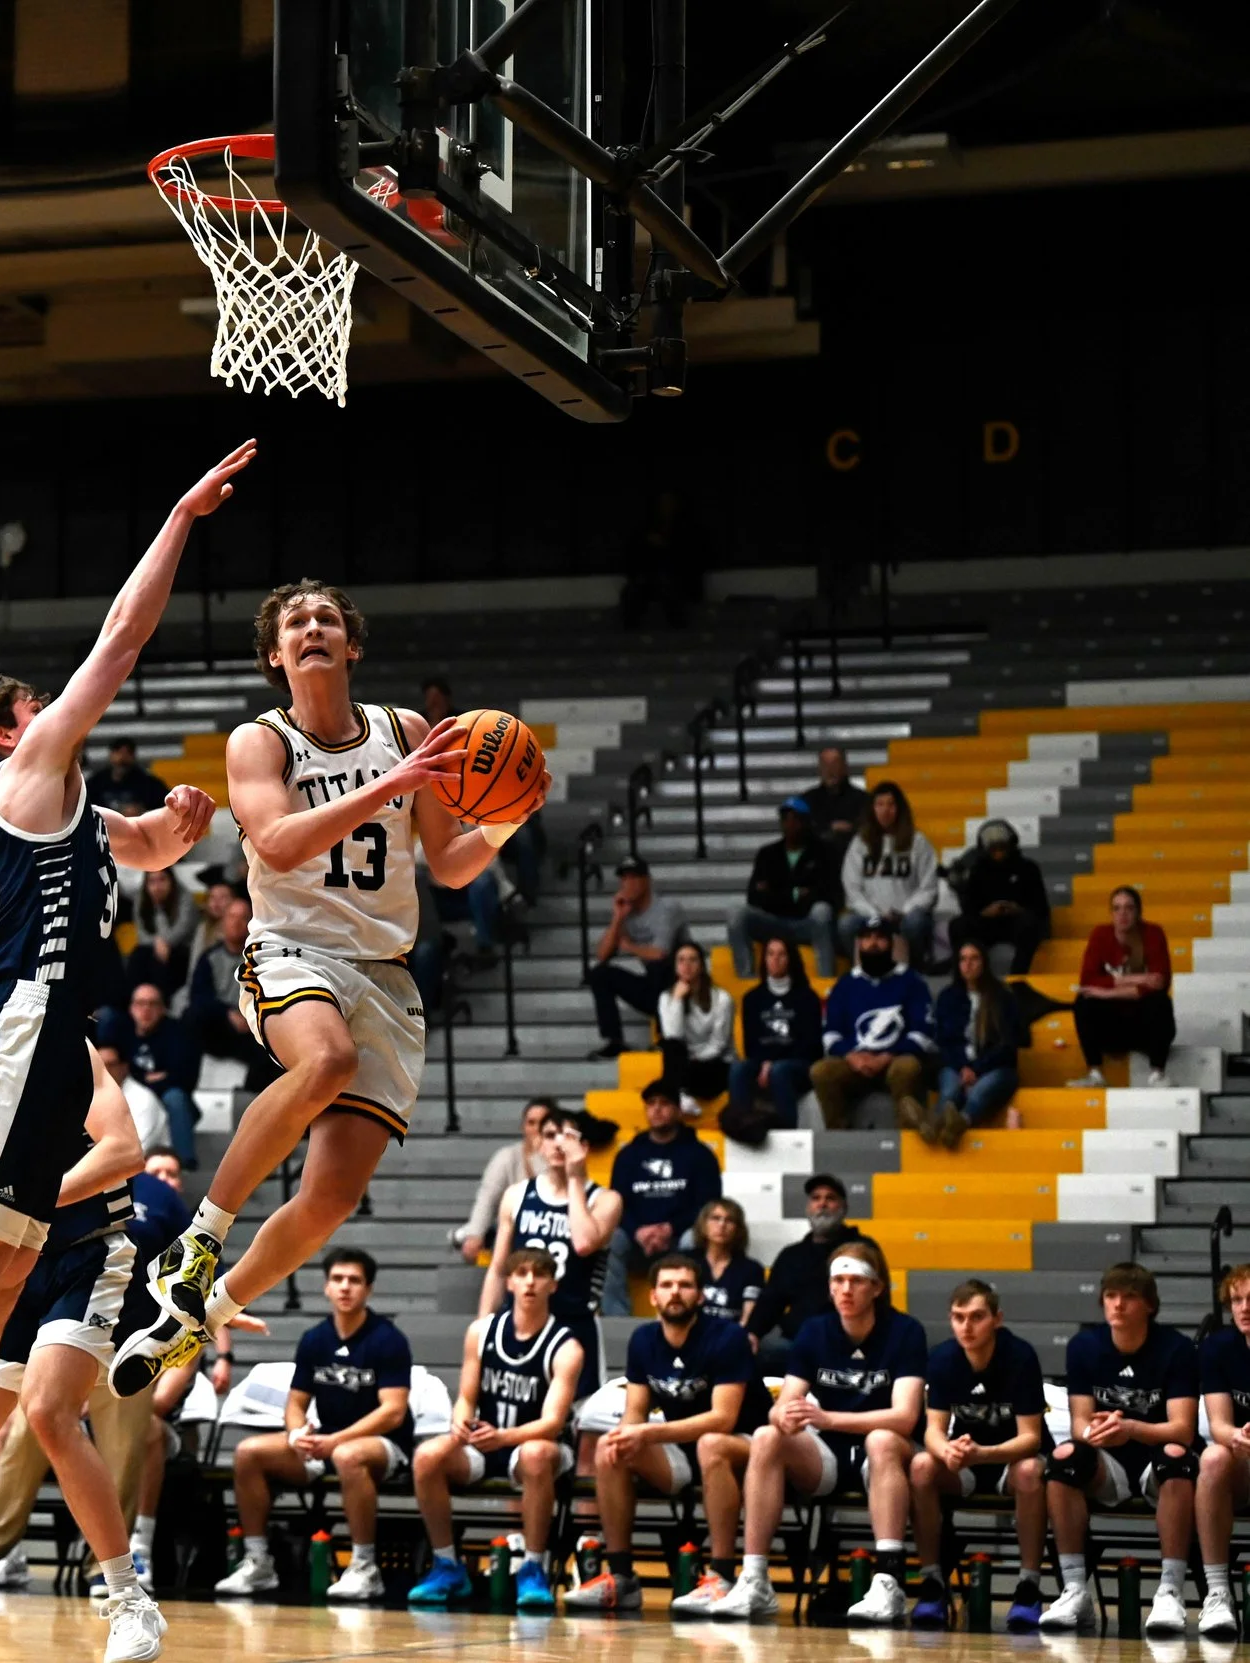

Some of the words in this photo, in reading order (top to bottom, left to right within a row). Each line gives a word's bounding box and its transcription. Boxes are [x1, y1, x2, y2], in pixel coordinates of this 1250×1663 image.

[826, 427, 862, 472] C
[981, 420, 1020, 464] D
[471, 715, 514, 774] Wilson
[297, 769, 403, 810] TITA
[323, 822, 387, 891] 13
[863, 855, 911, 877] DAD
